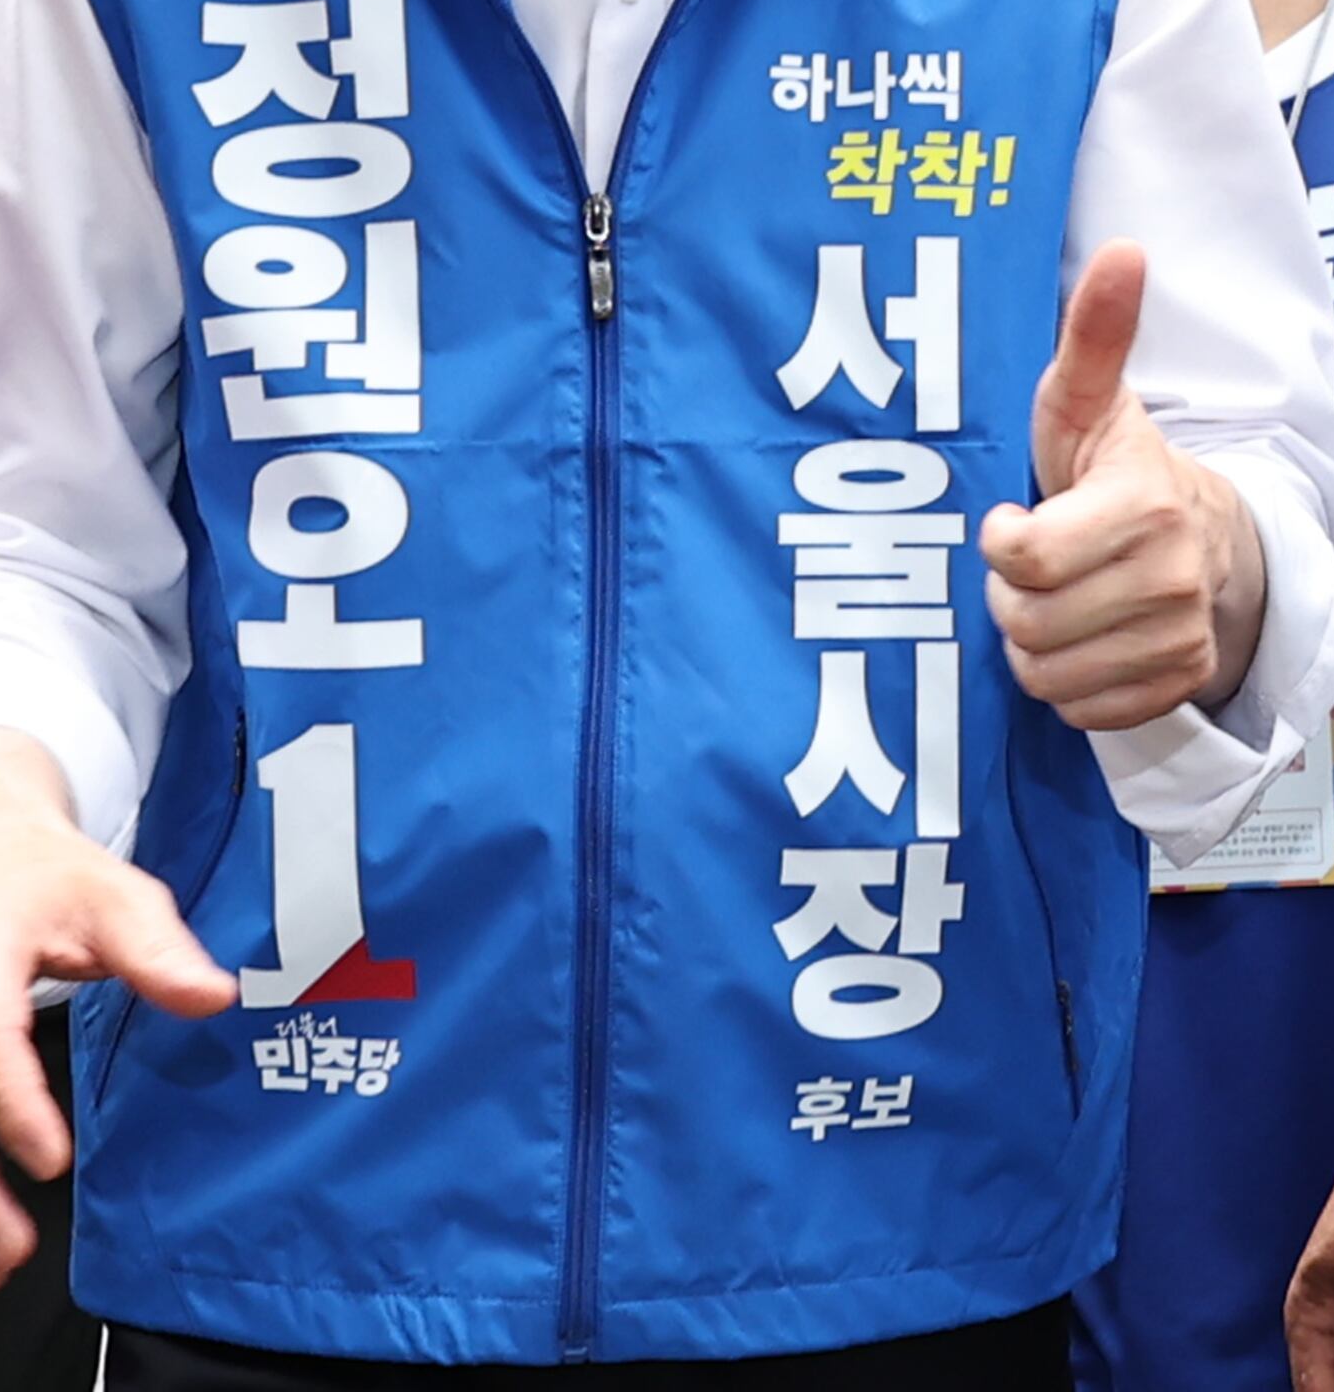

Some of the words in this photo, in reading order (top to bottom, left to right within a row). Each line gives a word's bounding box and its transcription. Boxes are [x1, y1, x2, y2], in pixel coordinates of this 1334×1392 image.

[769, 50, 961, 123] 하나씩
[826, 128, 1016, 217] 착착!
[772, 237, 965, 1040] 서울시장
[239, 723, 416, 1010] 1
[252, 1036, 402, 1098] 민주당
[790, 1075, 914, 1142] 후보
